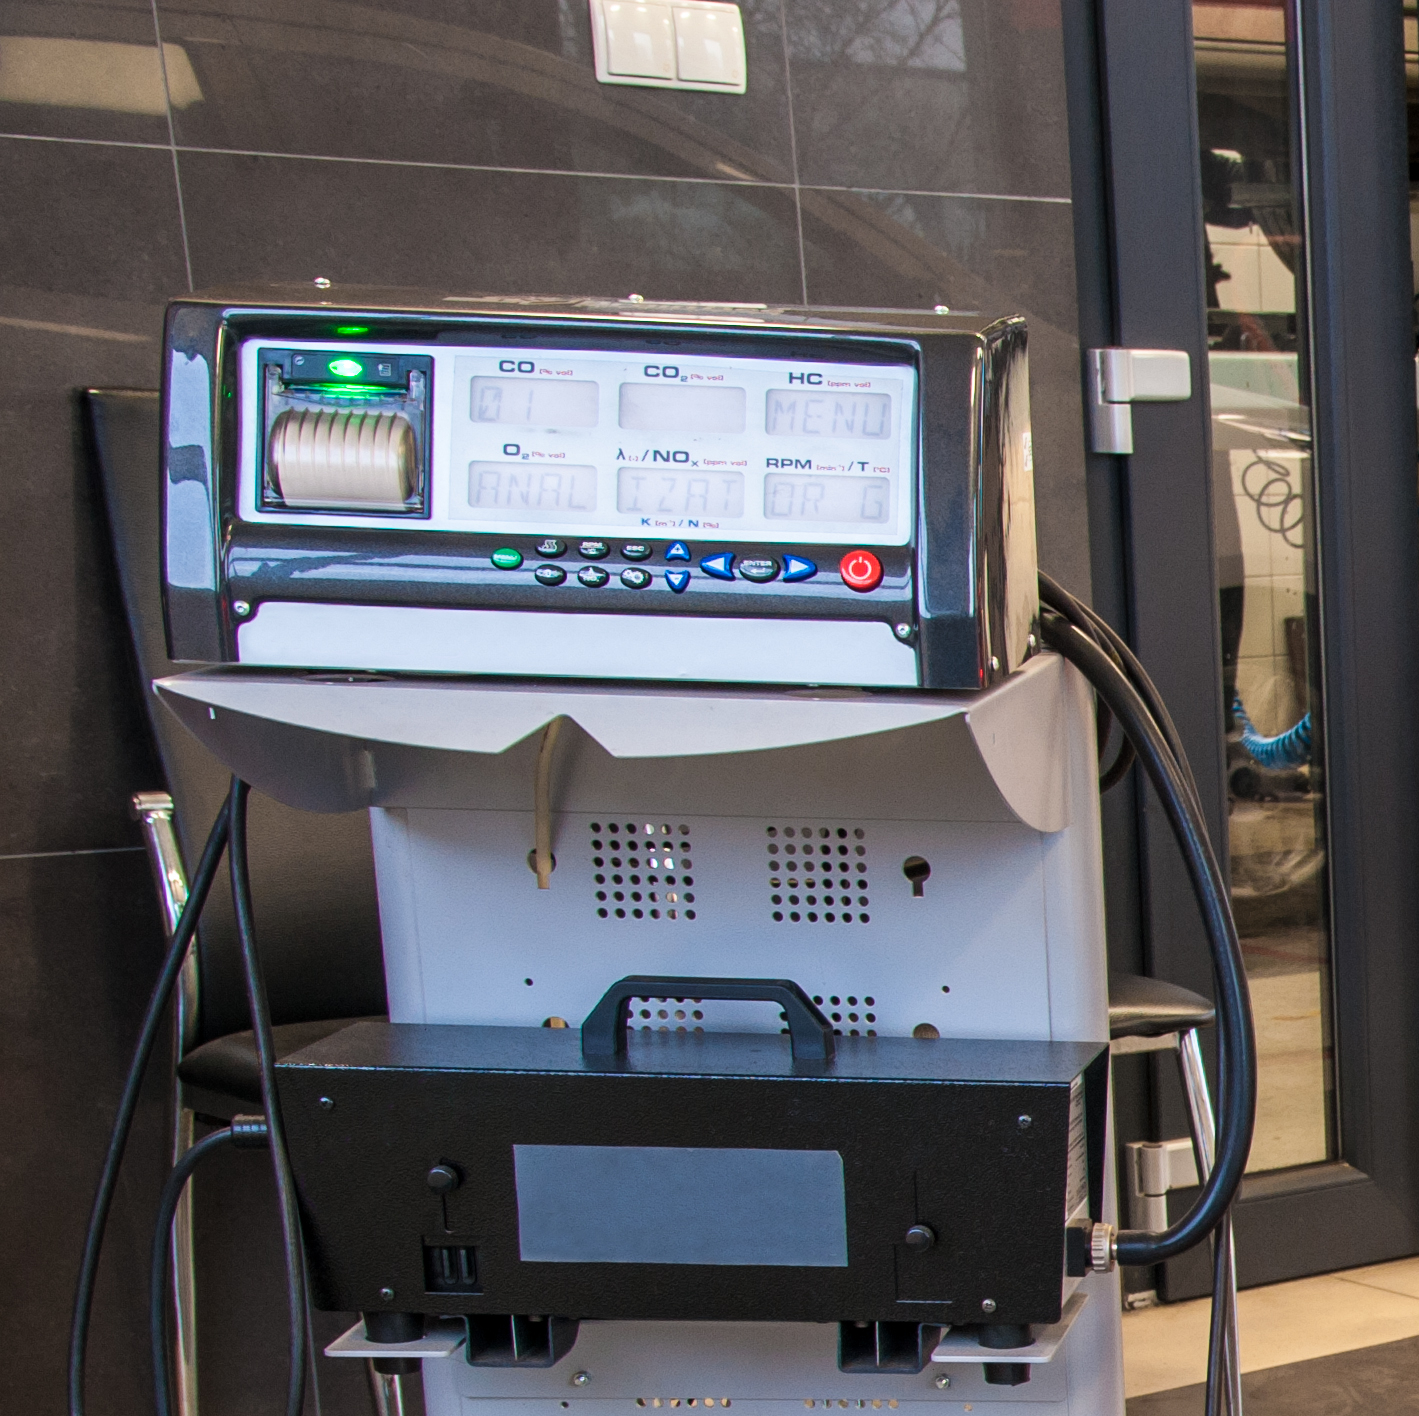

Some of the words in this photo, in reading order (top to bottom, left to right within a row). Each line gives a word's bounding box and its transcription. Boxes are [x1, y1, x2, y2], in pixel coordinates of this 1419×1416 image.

[499, 360, 535, 374] CO
[788, 371, 823, 385] HC
[771, 399, 887, 436] MENU
[766, 457, 812, 470] RPM
[857, 461, 870, 472] T
[475, 470, 588, 509] ANAL
[626, 476, 738, 512] IZAT
[860, 485, 884, 519] G
[641, 517, 651, 526] K
[688, 519, 699, 528] N
[743, 560, 772, 568] ENTER
